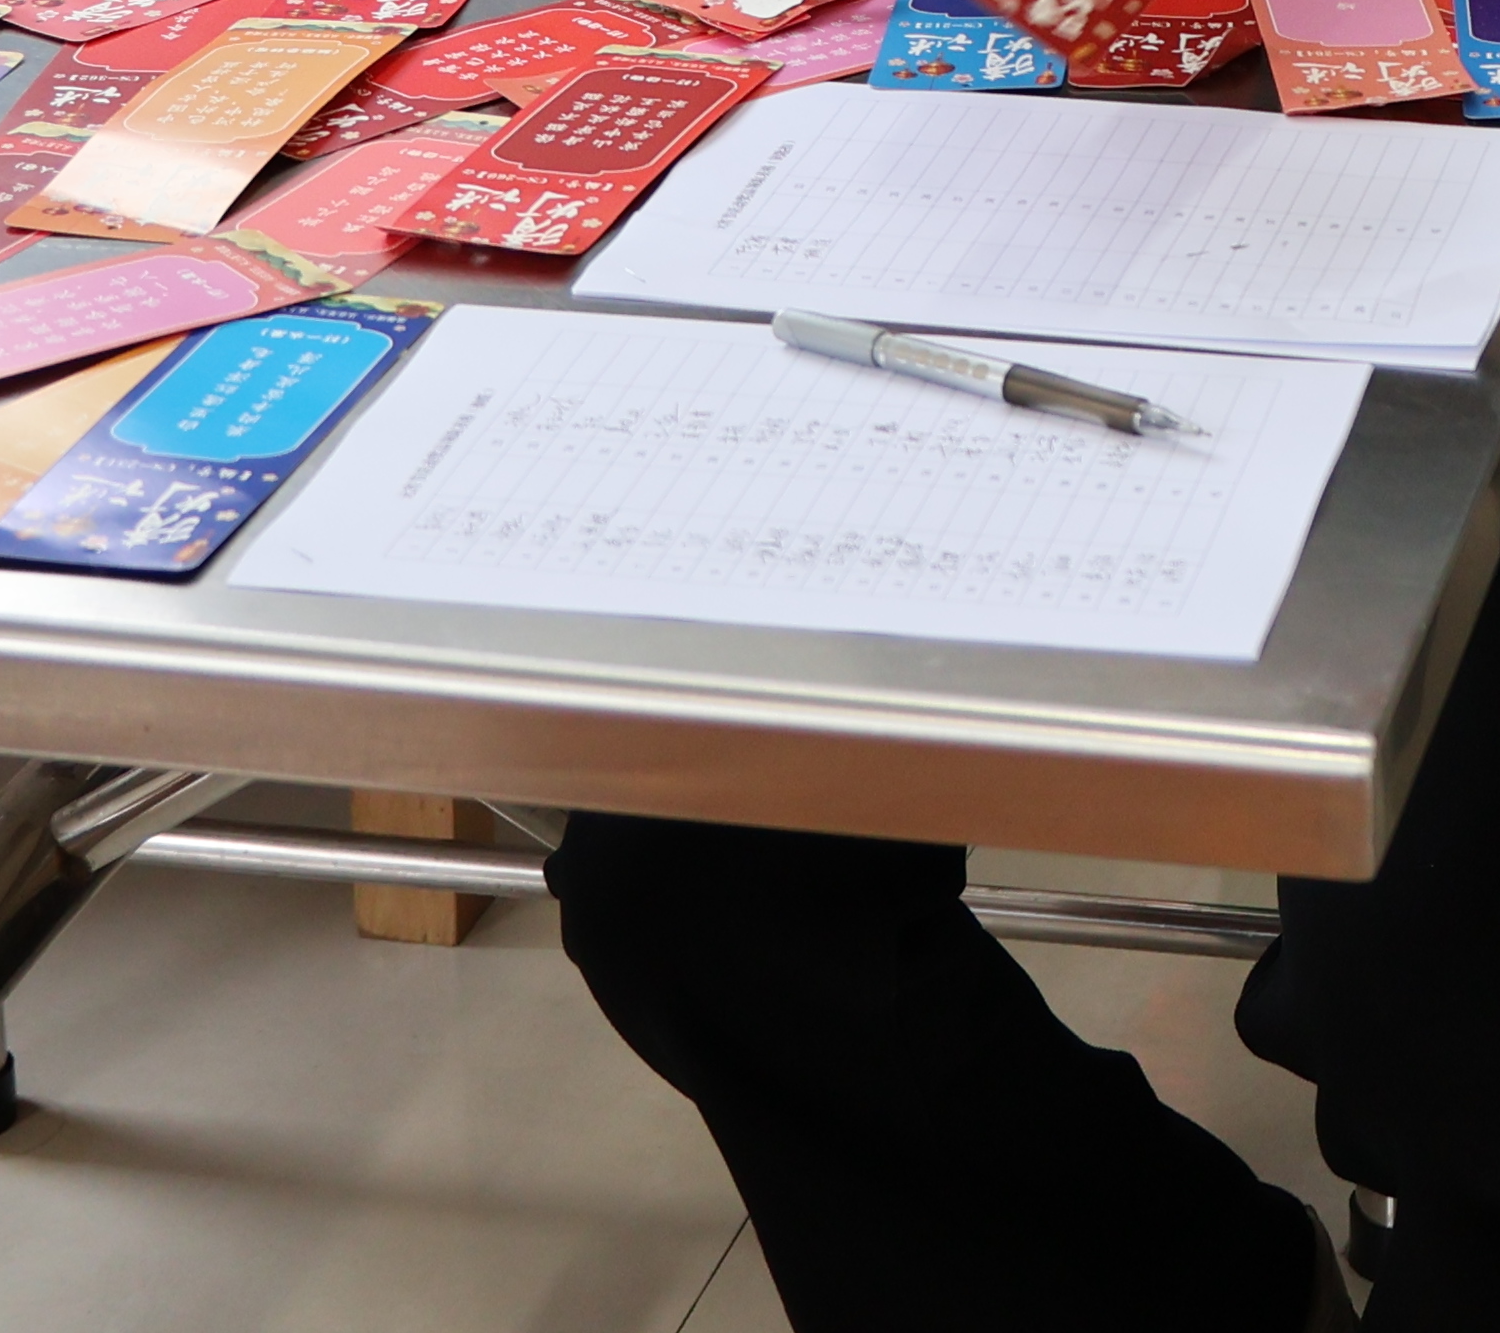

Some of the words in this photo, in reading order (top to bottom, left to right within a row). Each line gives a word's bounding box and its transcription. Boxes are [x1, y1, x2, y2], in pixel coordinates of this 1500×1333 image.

[905, 32, 1036, 81] 猜灯谜
[1291, 60, 1442, 101] 猜灯谜
[444, 182, 588, 249] 猜灯谜
[57, 473, 220, 550] 猜灯谜
